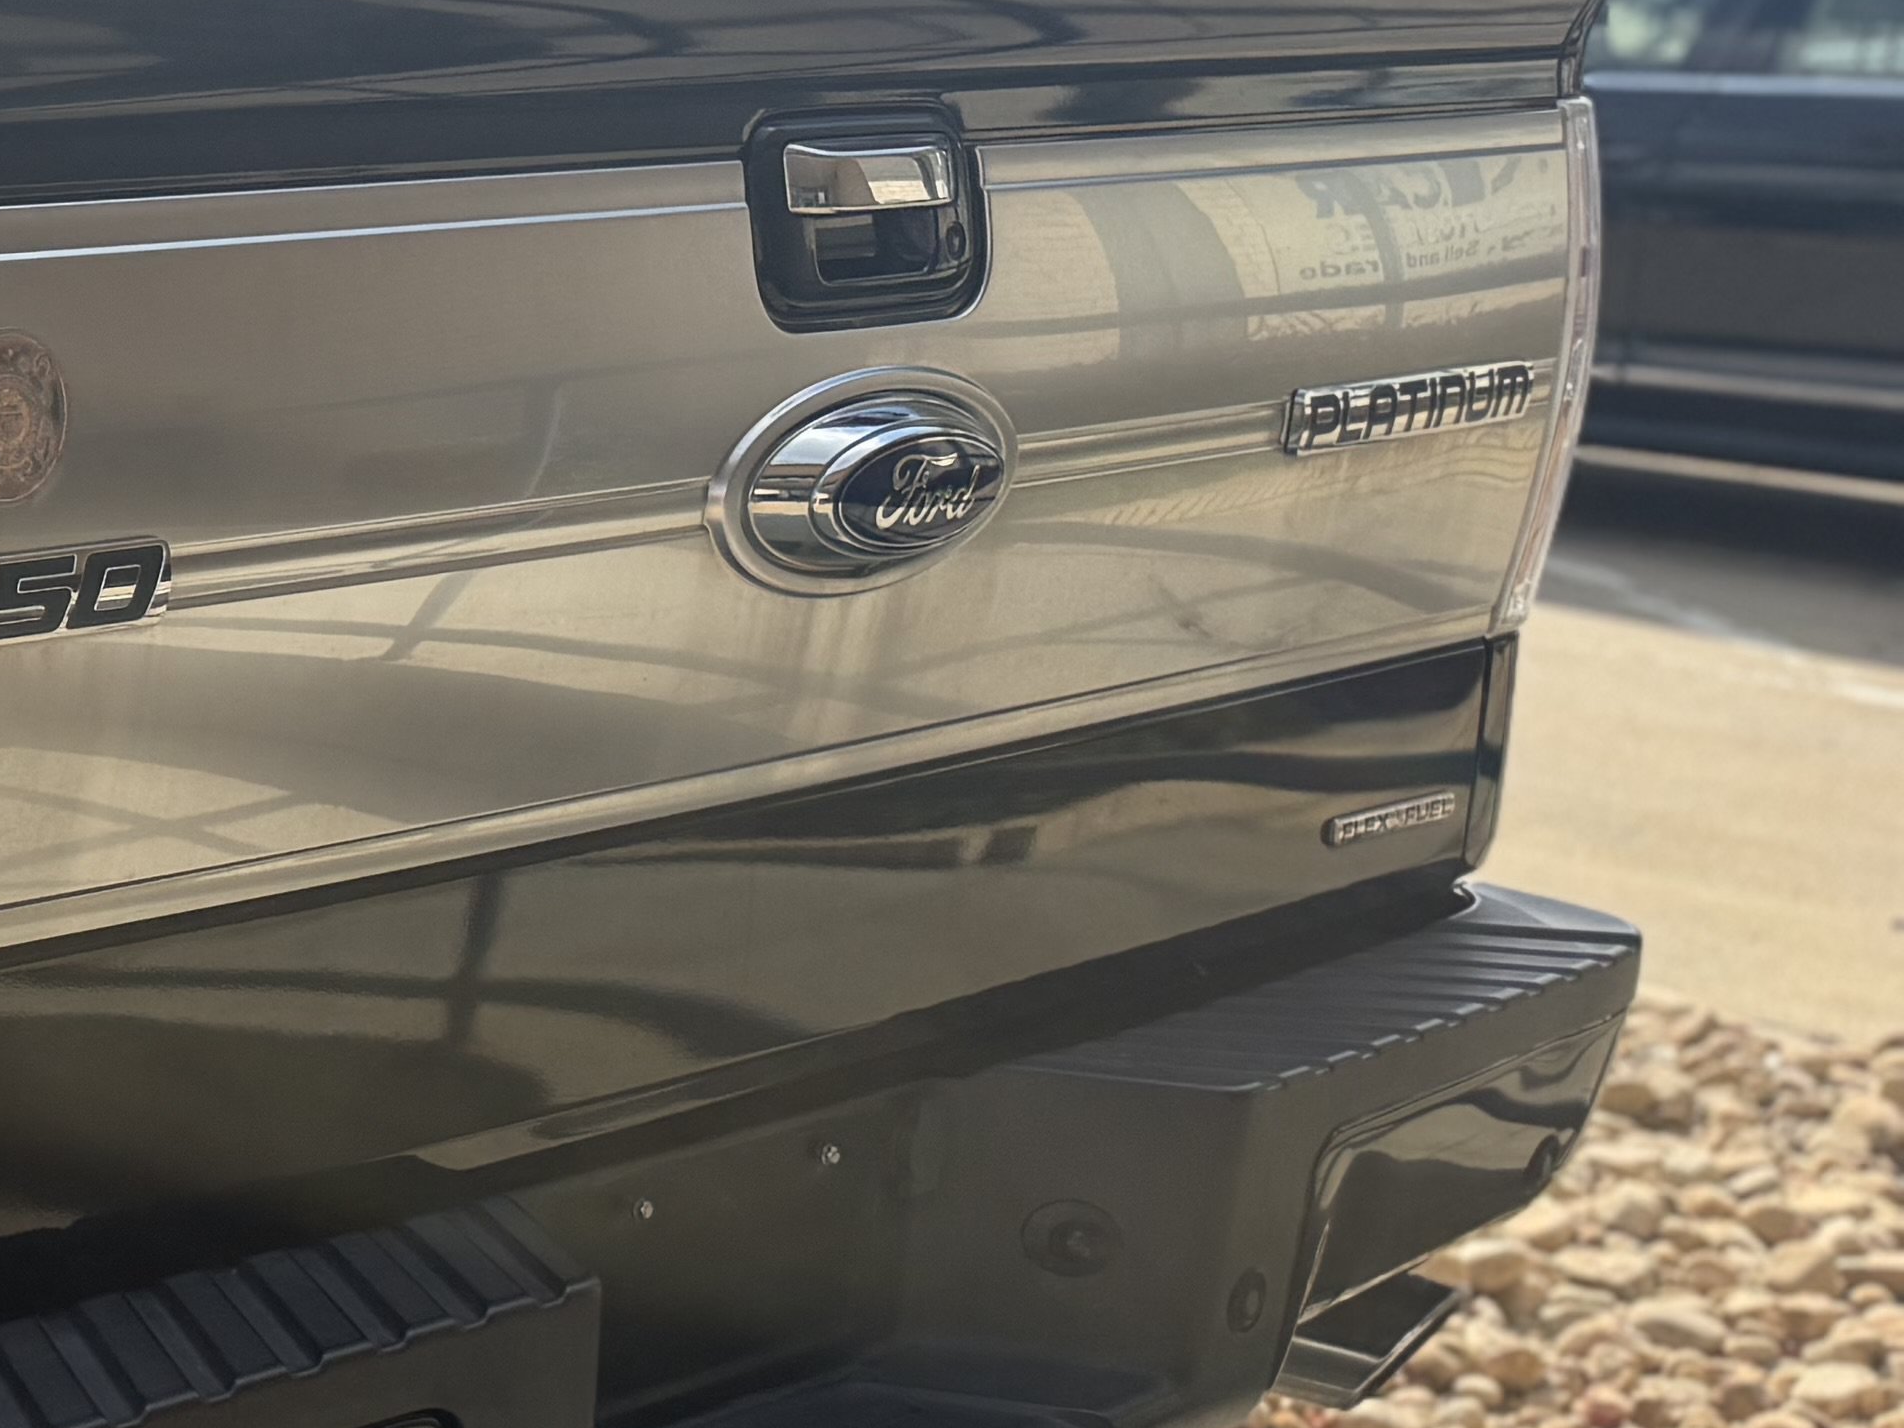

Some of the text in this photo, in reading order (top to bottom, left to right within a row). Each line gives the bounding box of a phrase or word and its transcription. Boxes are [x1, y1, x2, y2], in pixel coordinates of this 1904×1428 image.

[1304, 363, 1532, 449] PLATINUM
[876, 452, 980, 530] Ford
[1404, 797, 1453, 826] FUEL
